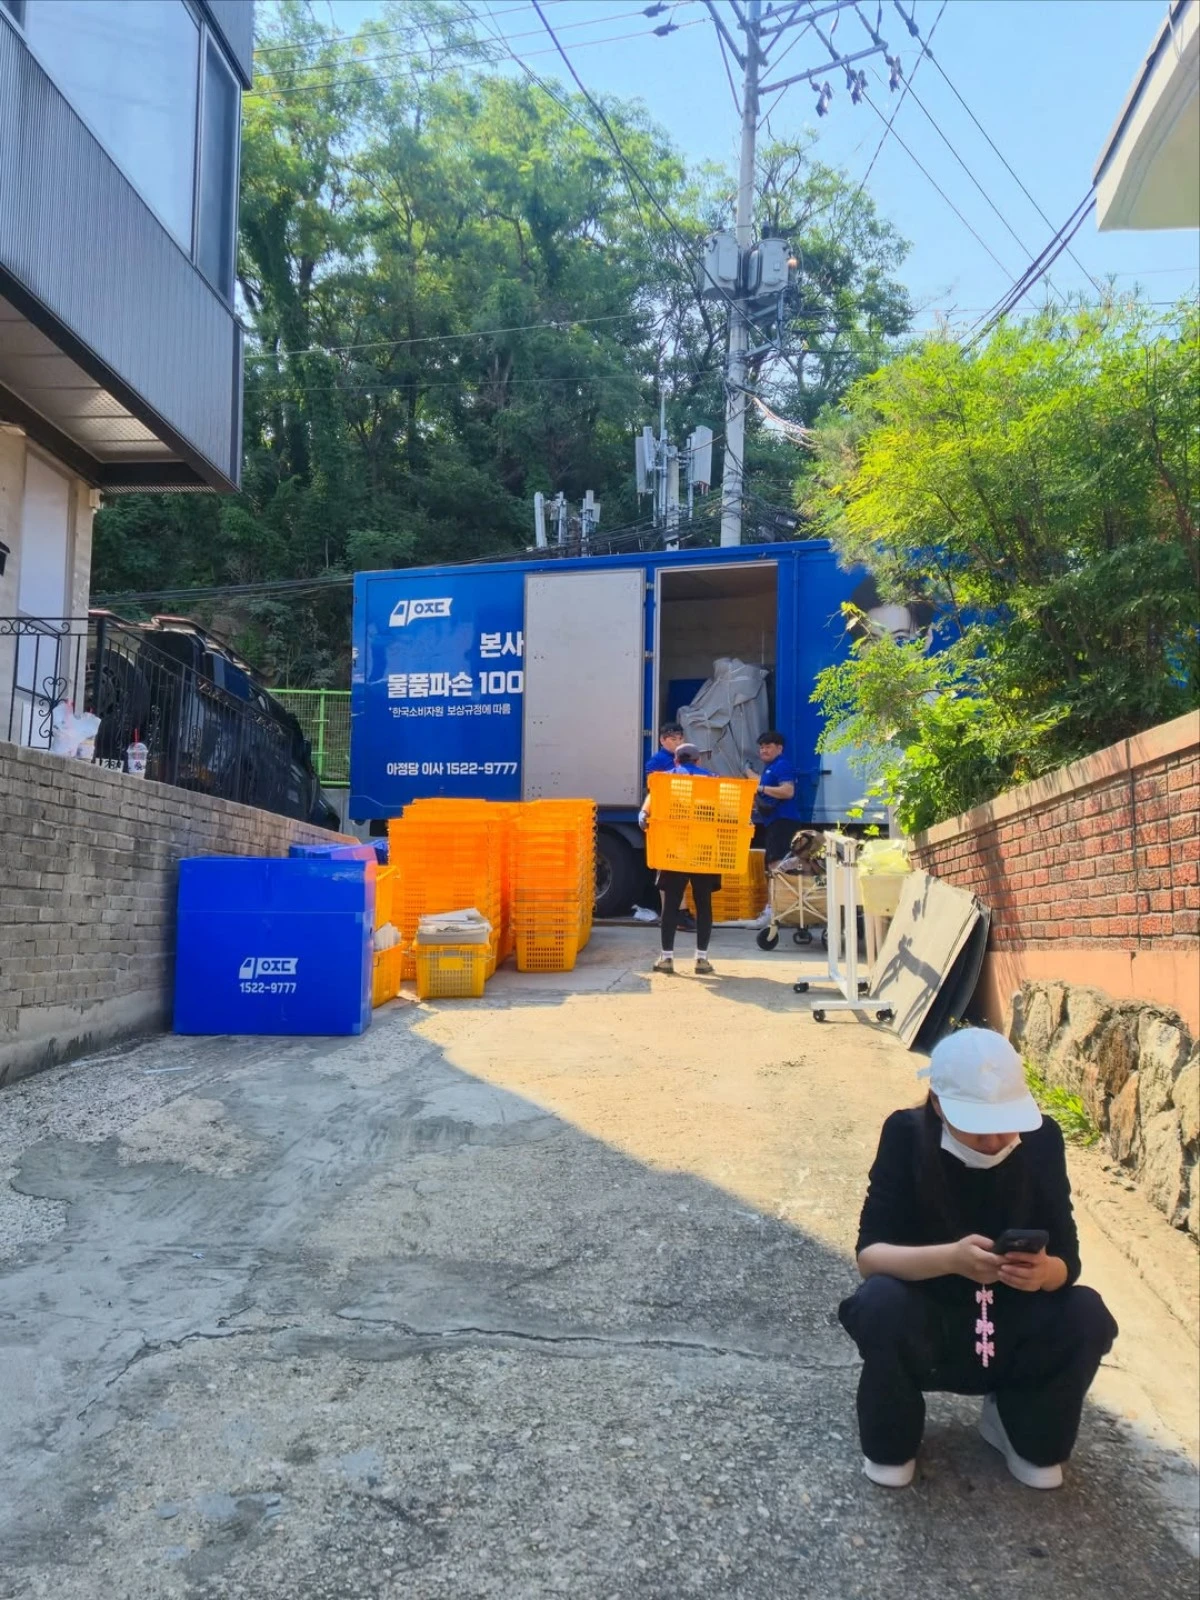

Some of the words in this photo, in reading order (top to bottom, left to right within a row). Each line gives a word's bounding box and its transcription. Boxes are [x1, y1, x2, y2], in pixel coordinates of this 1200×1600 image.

[480, 631, 524, 658] 본사
[388, 672, 473, 698] 물품파손
[479, 671, 524, 694] 100
[447, 704, 491, 716] 보상규정에
[387, 763, 419, 775] 아정당
[422, 763, 444, 775] 이사
[446, 762, 518, 775] 1522-9777
[240, 982, 297, 994] 1522-9777
